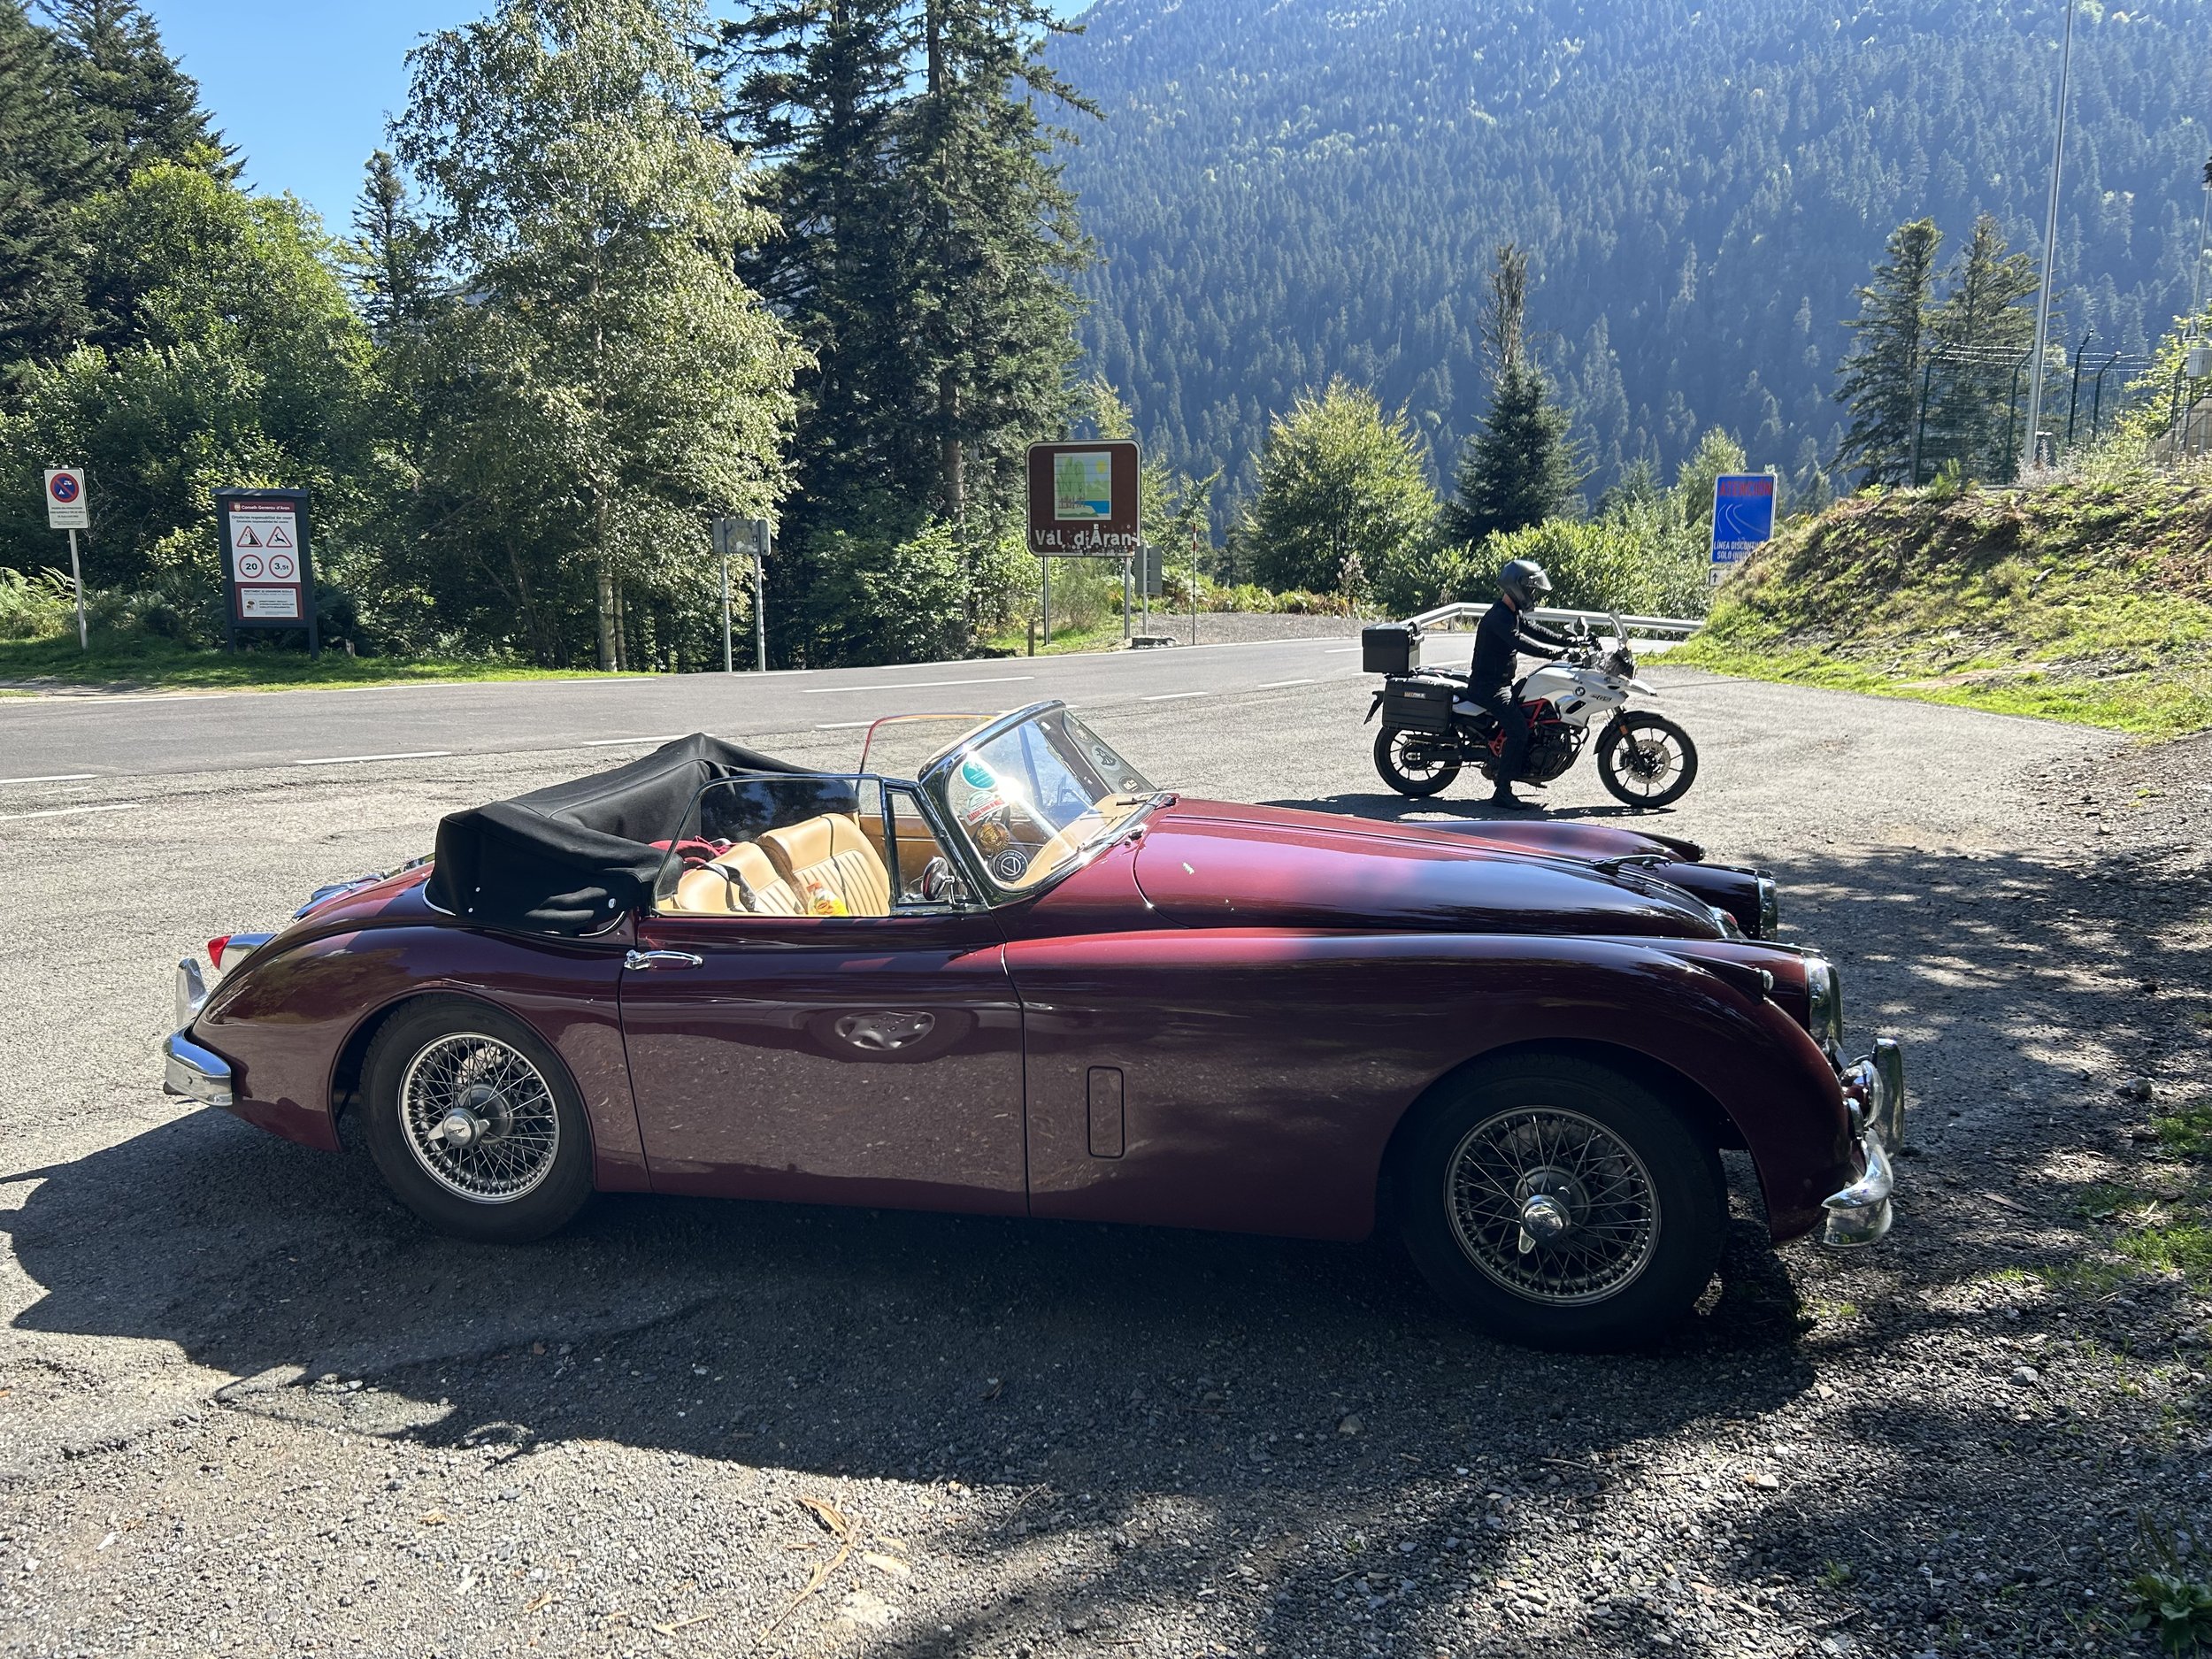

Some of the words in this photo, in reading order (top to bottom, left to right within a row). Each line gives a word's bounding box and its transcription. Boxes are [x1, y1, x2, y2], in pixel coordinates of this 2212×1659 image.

[1720, 480, 1772, 495] ATENCIÓN
[1034, 529, 1063, 546] Val
[1713, 539, 1730, 550] LÍNEA
[1717, 550, 1732, 560] SOLO
